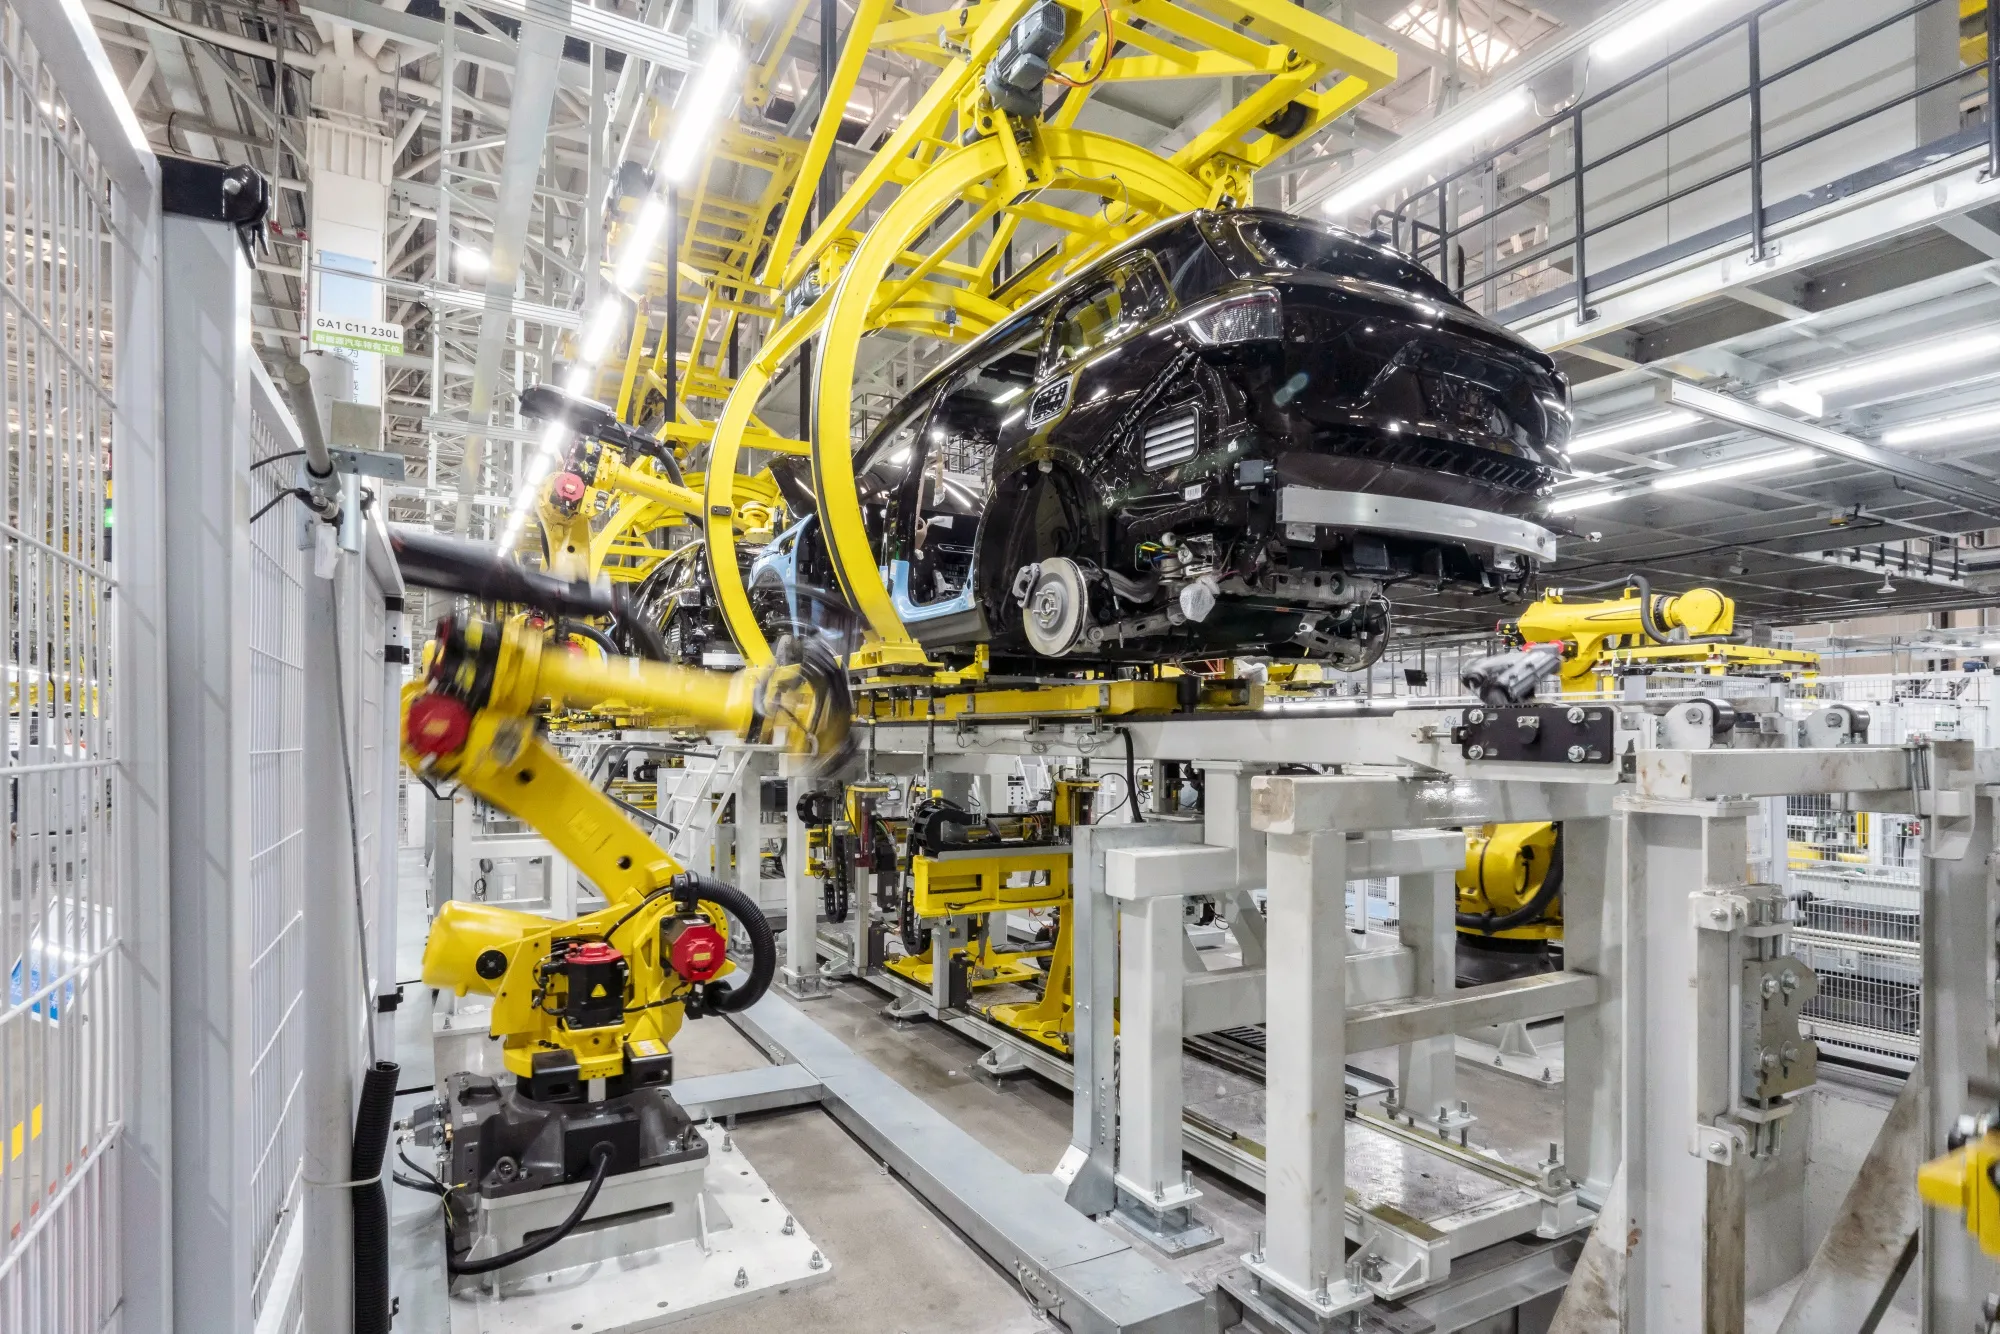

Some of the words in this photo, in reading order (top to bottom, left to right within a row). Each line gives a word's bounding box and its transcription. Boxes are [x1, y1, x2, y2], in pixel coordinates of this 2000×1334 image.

[316, 318, 341, 330] GA1
[345, 322, 367, 334] C11
[371, 326, 400, 339] 230L
